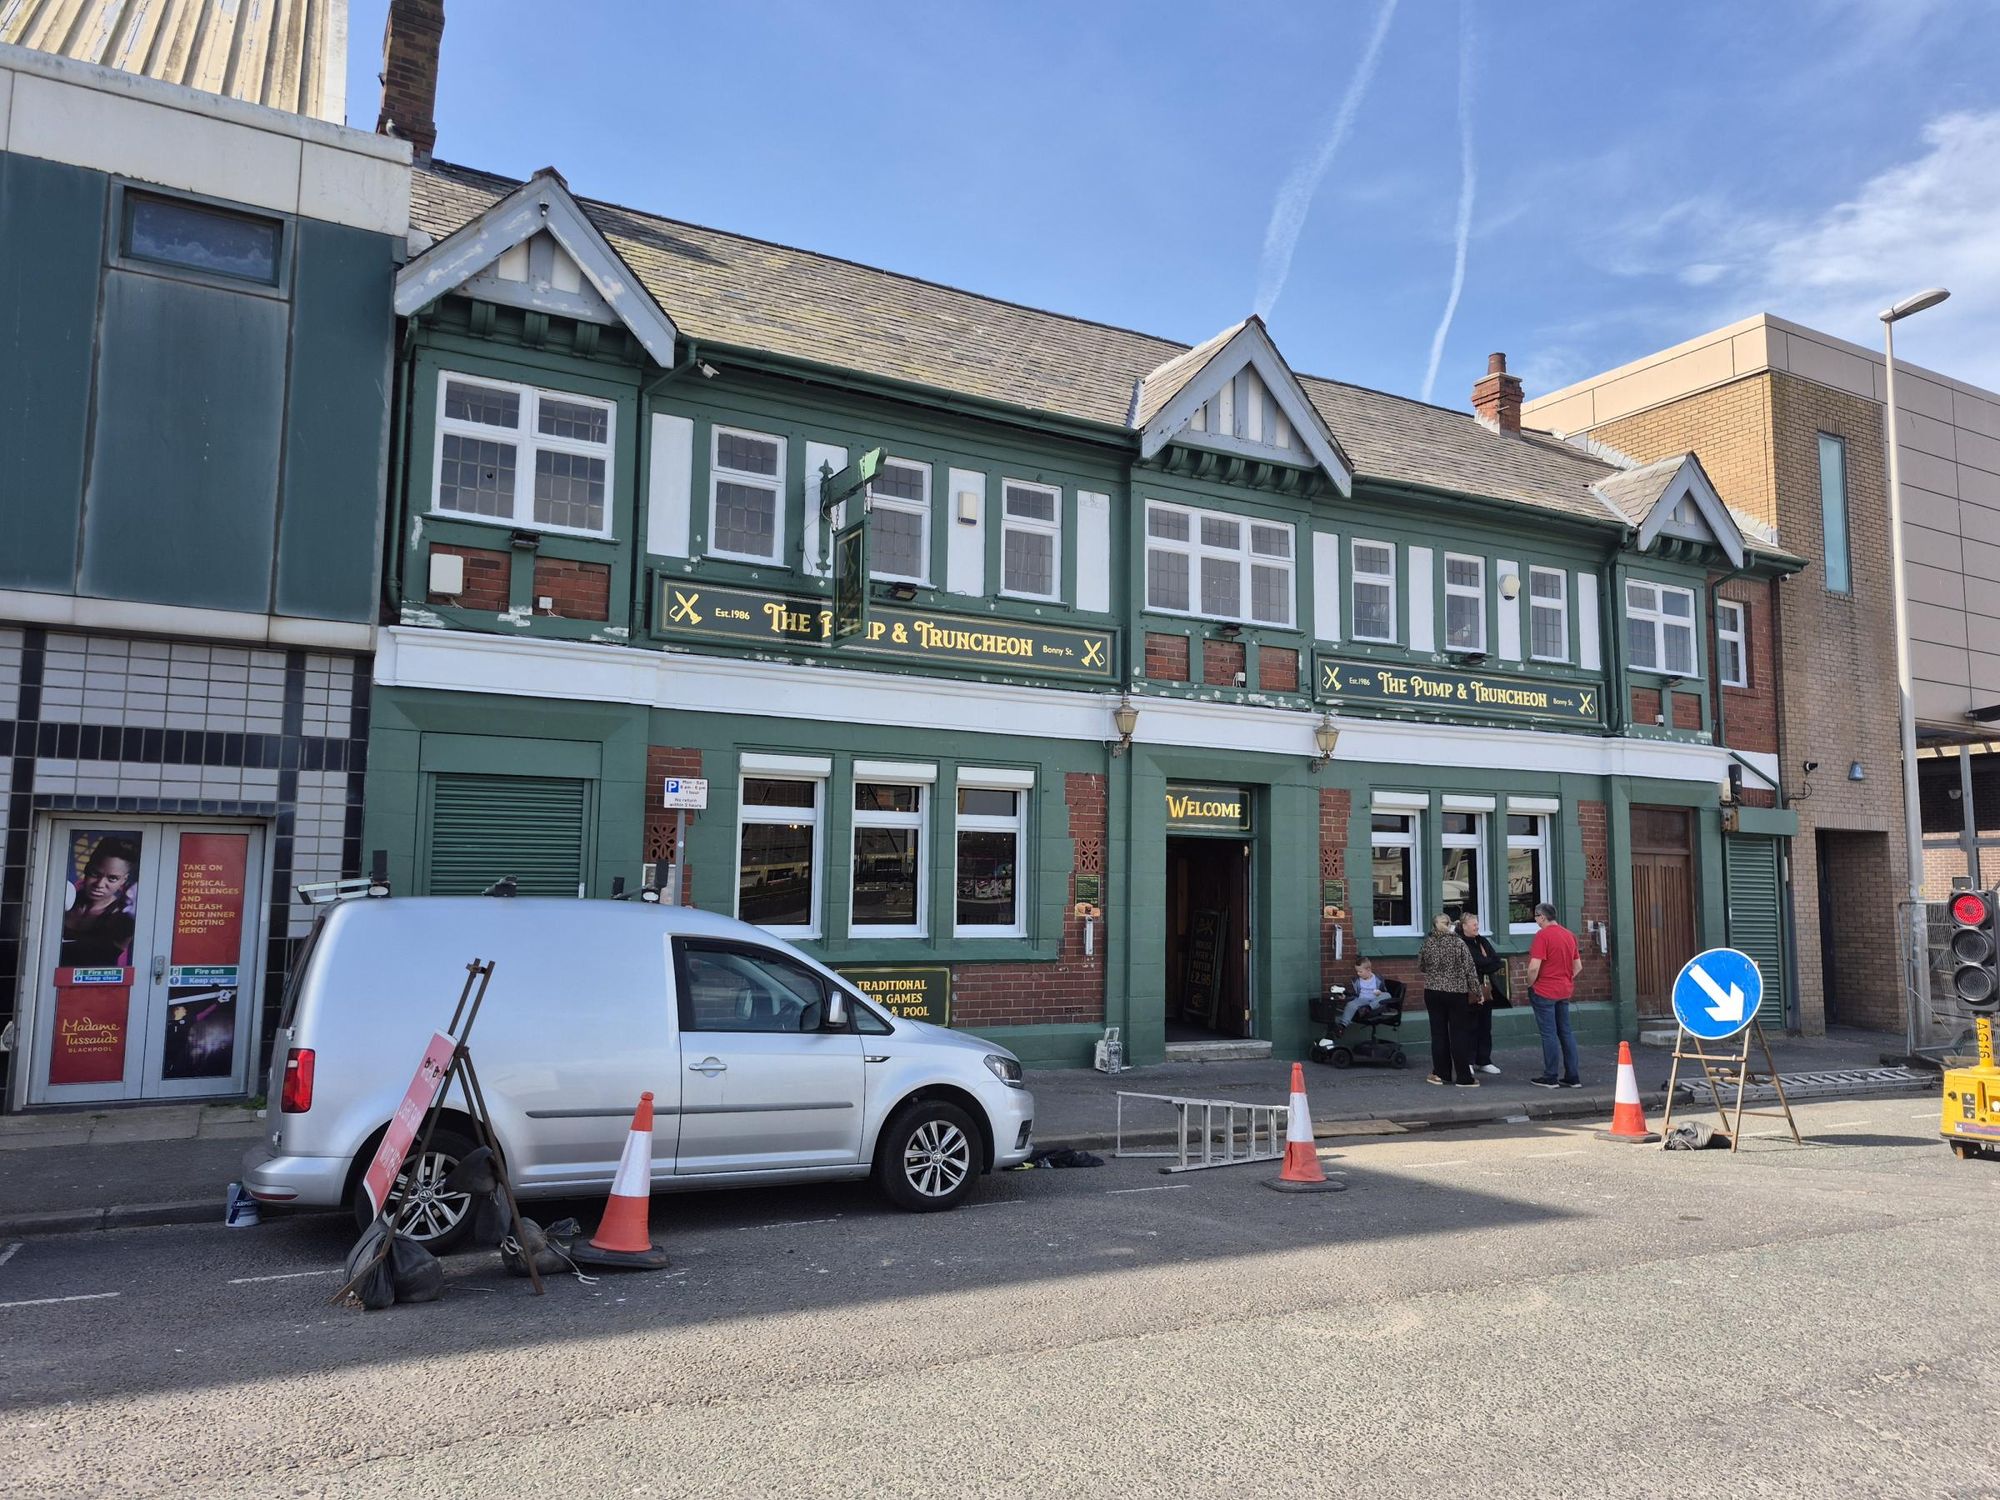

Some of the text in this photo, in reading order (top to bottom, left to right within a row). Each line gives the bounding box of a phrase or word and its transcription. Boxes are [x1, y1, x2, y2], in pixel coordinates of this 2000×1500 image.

[715, 608, 750, 621] Est.1986
[763, 602, 811, 633] THE
[892, 622, 909, 644] &
[914, 621, 1034, 657] TRUNCHEON
[1042, 645, 1064, 656] Bonny
[1349, 677, 1371, 686] Est.1986
[1377, 671, 1548, 708] THE PUMP & TRUNCHEON
[1165, 795, 1242, 818] WELCOME
[188, 977, 209, 985] Keep
[857, 980, 927, 991] TRADITIONAL
[886, 993, 923, 1003] GAMES
[903, 1007, 930, 1016] POOL
[63, 1017, 120, 1032] Madame
[62, 1031, 118, 1046] Tussauds
